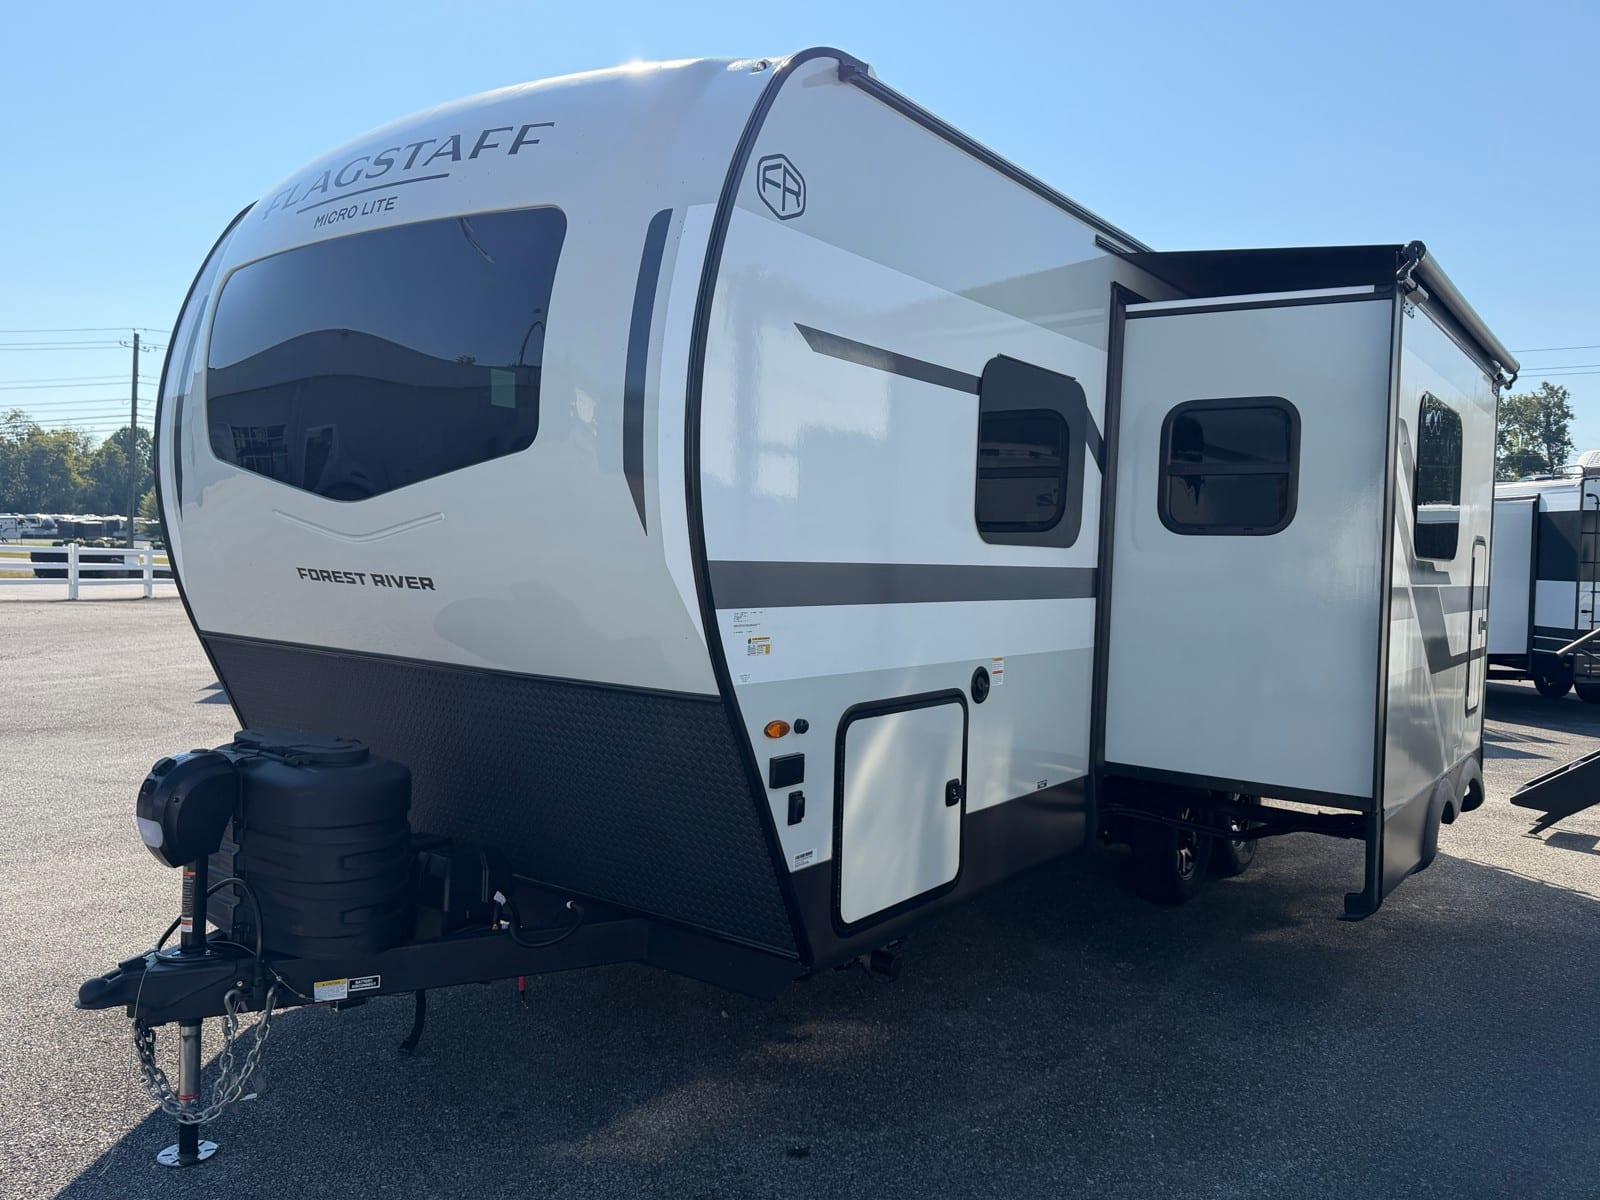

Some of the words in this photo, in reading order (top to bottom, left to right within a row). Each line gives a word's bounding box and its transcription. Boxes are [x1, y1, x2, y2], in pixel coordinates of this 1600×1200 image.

[263, 122, 555, 220] FLAGSTAFF
[313, 201, 357, 228] MICRO
[361, 196, 398, 215] LITE
[296, 567, 366, 585] FOREST
[370, 573, 436, 591] RIVER
